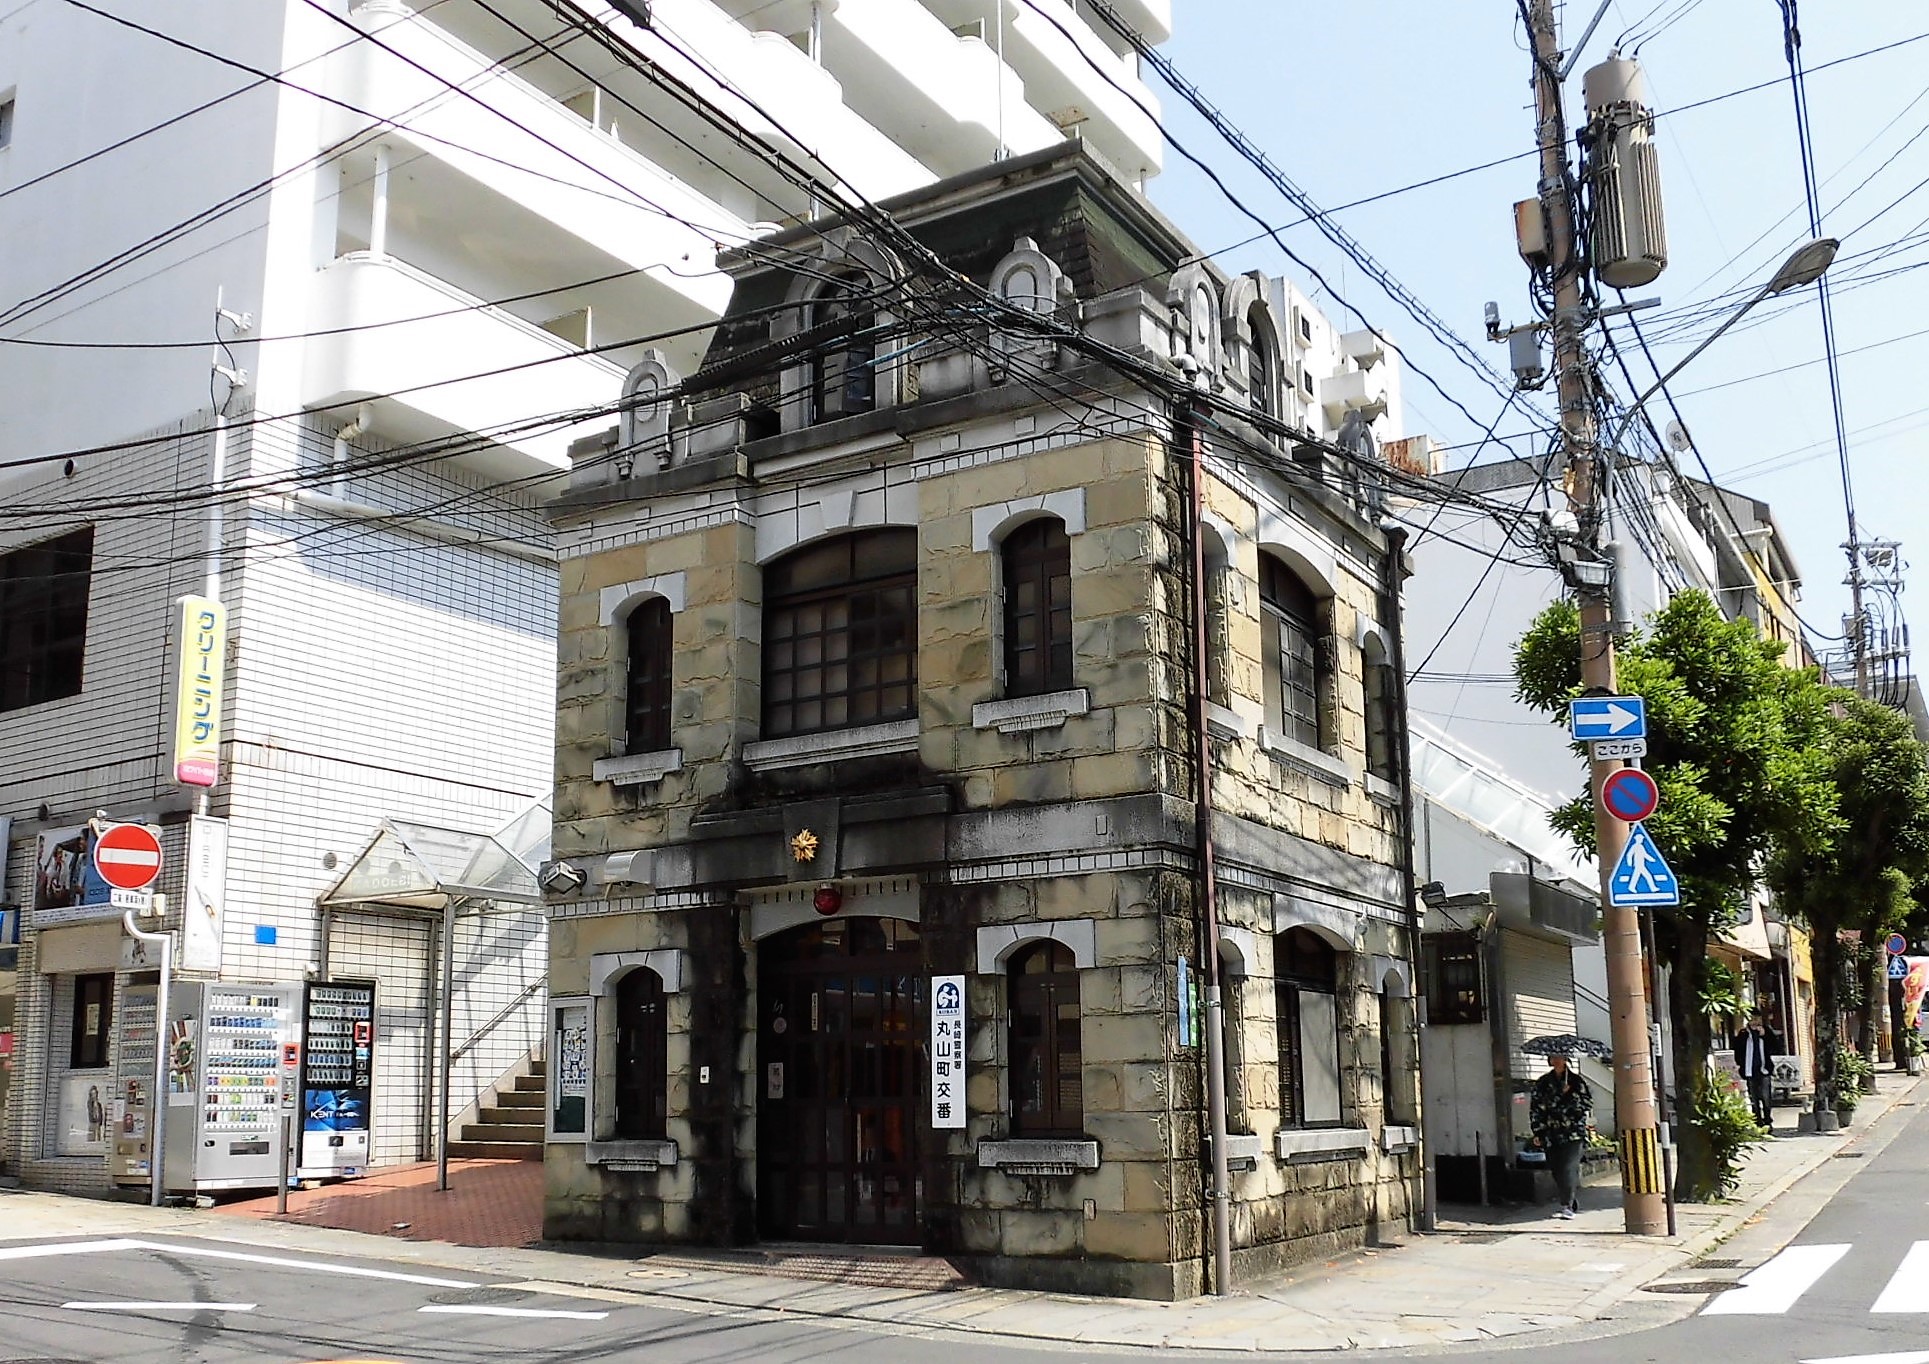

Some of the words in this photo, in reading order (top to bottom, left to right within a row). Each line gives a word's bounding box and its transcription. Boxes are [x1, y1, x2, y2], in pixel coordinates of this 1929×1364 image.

[193, 611, 215, 742] クリーニング
[1598, 743, 1643, 755] ここから
[936, 1020, 951, 1119] 丸山町交番
[953, 1020, 962, 1070] 長崎警察署
[310, 1109, 334, 1119] KENT
